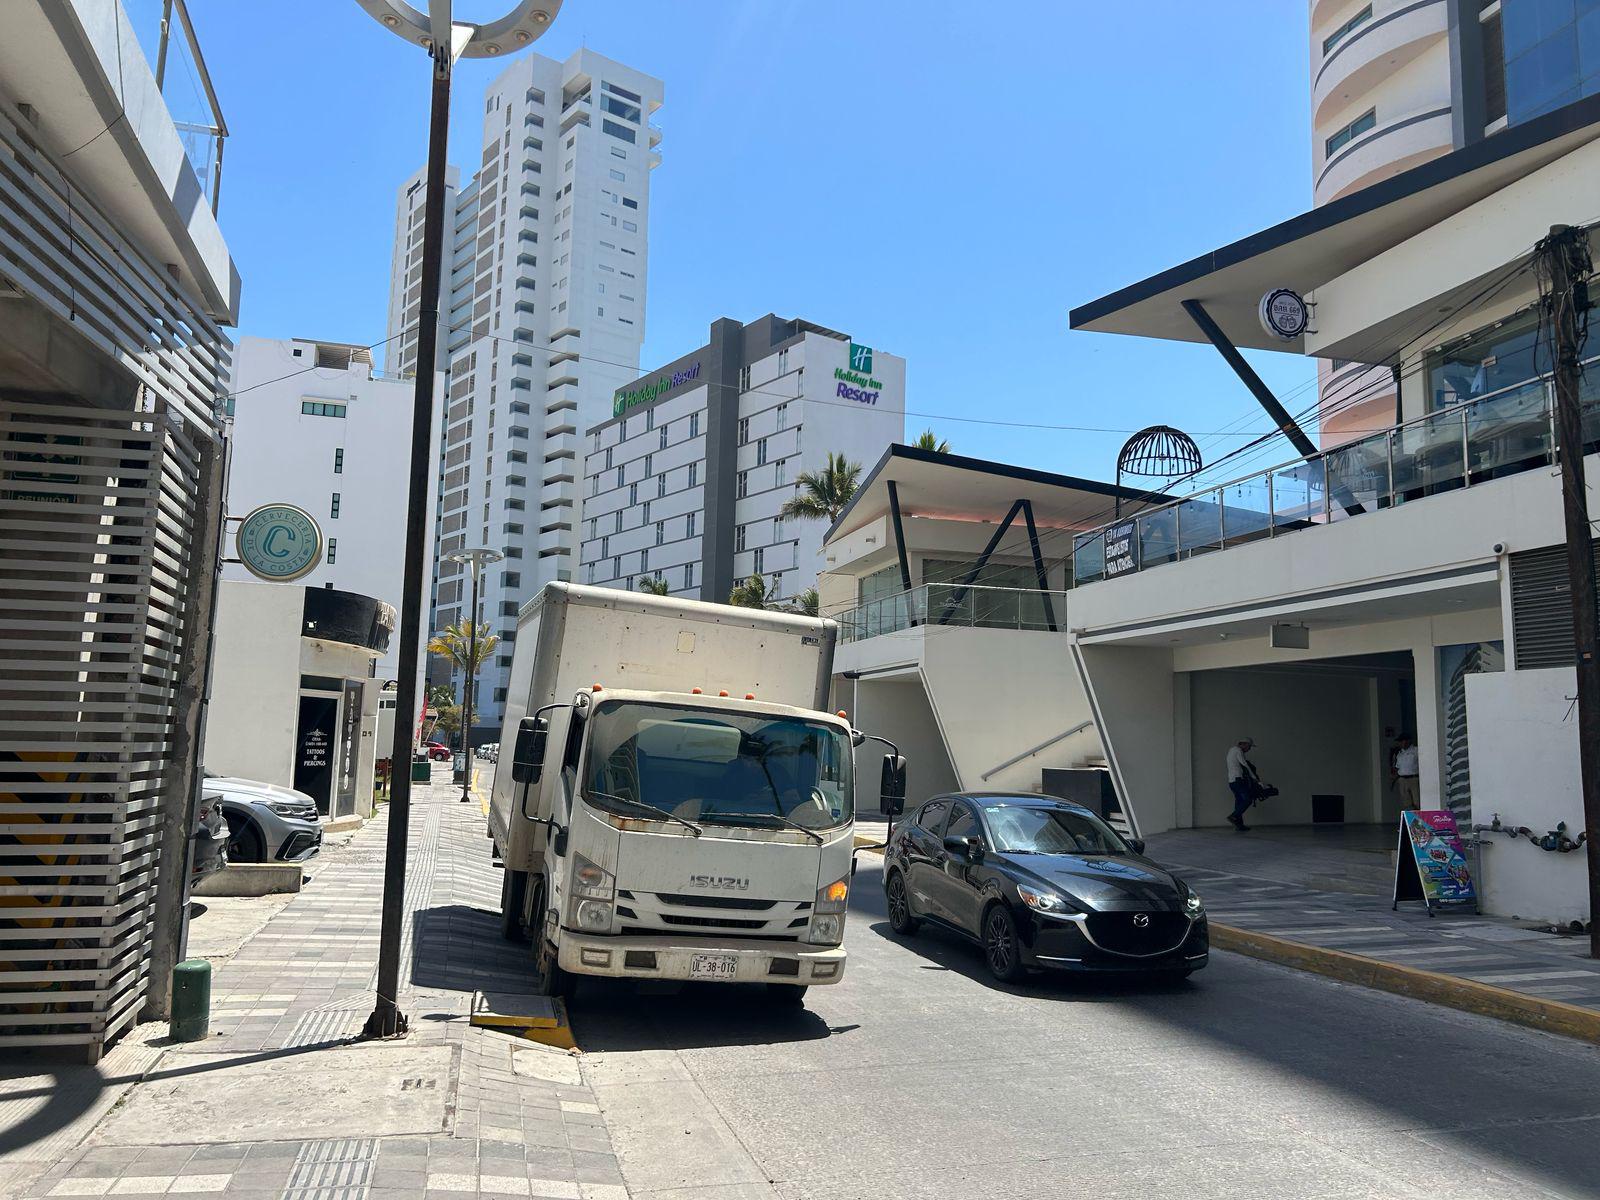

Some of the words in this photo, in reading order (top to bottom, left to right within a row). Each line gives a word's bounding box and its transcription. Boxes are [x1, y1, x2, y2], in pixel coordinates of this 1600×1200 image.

[627, 384, 657, 407] Holiday
[657, 376, 671, 393] Inn
[671, 361, 700, 388] Resort
[834, 367, 868, 388] Holiday
[868, 377, 883, 390] Inn
[836, 381, 880, 406] Resort
[263, 525, 296, 558] C
[270, 556, 305, 571] COSTA
[690, 875, 750, 891] ISUZU
[692, 961, 736, 973] UL-38-016
